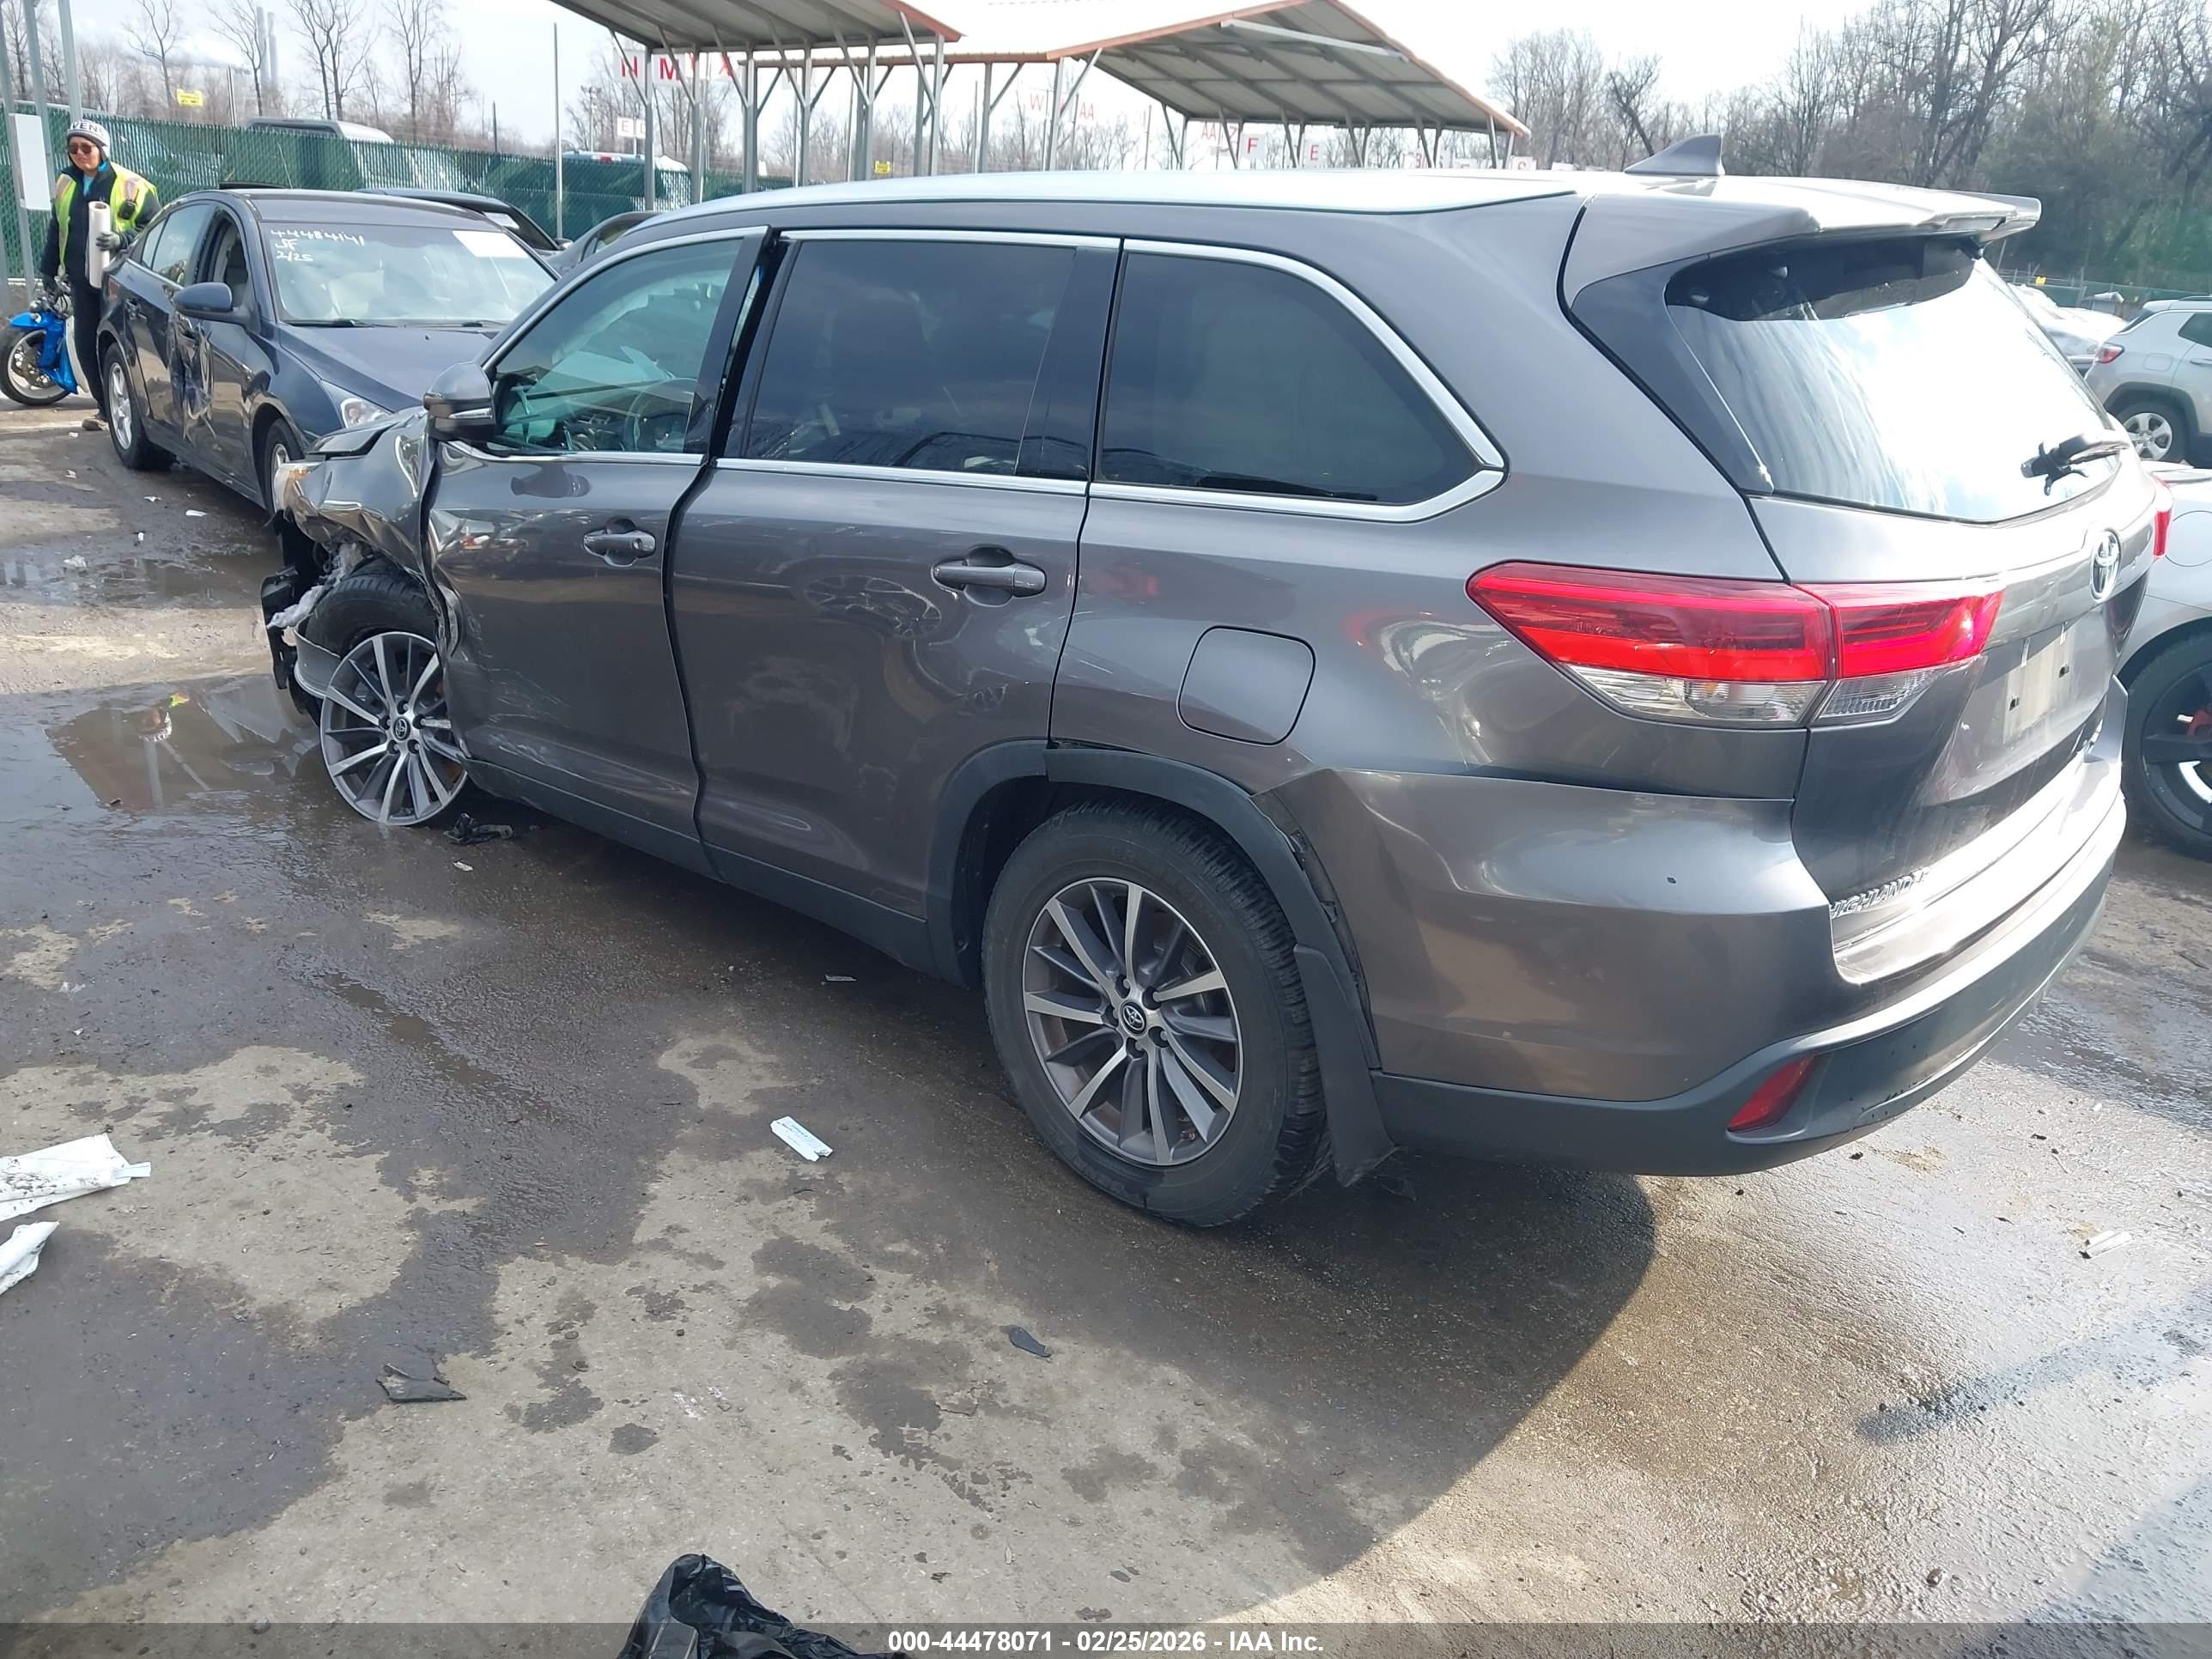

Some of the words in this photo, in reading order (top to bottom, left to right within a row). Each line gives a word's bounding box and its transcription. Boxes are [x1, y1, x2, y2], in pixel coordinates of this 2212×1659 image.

[621, 55, 638, 77] N
[659, 58, 681, 81] M
[1247, 137, 1260, 154] F
[1310, 144, 1320, 161] E
